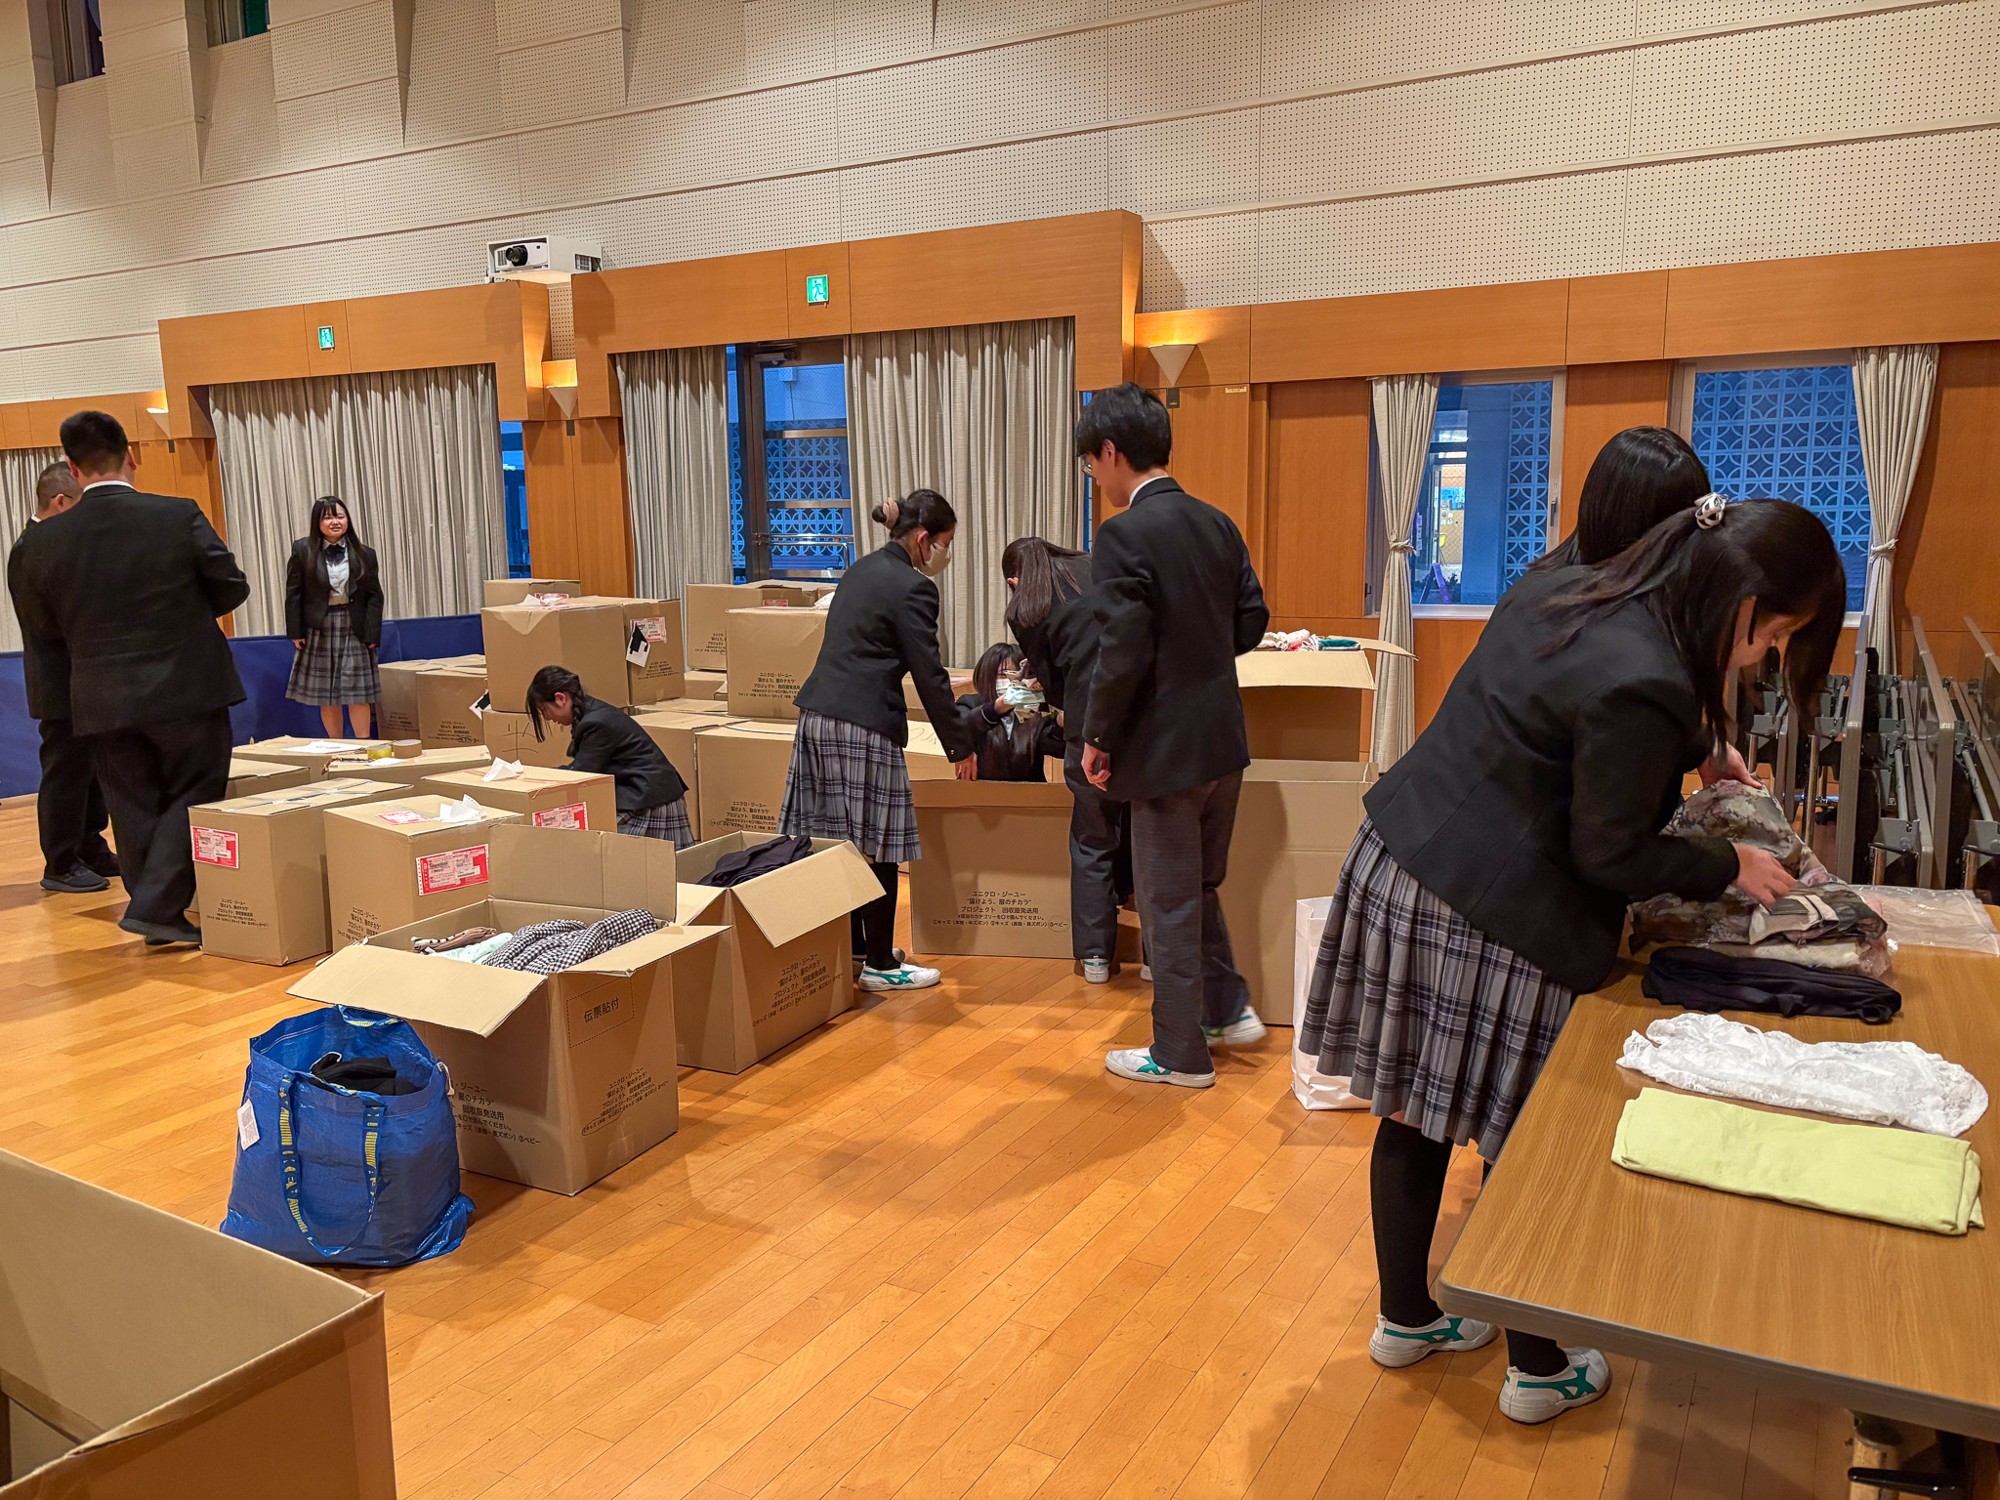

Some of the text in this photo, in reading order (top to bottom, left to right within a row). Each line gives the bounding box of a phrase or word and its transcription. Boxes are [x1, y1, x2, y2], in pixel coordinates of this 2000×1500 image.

[781, 953, 818, 976] ユニクロ・ジーユー
[773, 982, 799, 999] プロジェクト
[584, 997, 619, 1023] 伝票貼付
[451, 1081, 487, 1093] ・ジーユー
